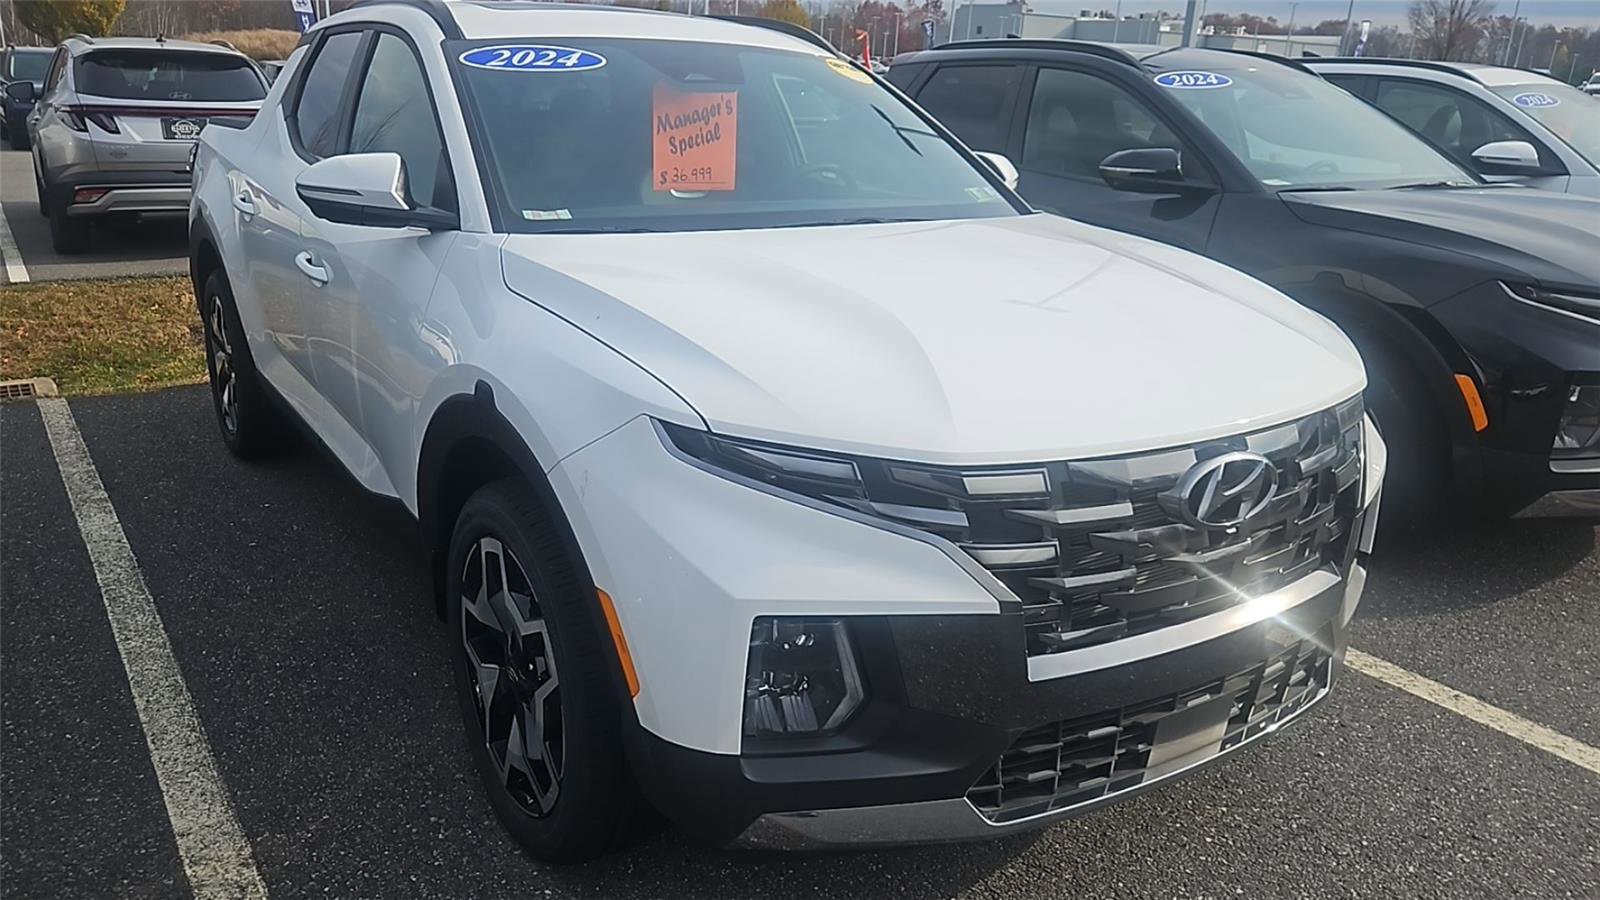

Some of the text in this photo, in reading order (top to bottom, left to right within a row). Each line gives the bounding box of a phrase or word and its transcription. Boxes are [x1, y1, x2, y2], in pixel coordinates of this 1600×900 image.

[486, 49, 582, 67] 2024
[1169, 73, 1218, 86] 2024
[1521, 95, 1554, 106] 2024
[656, 94, 734, 135] Manager's
[668, 122, 721, 156] Special
